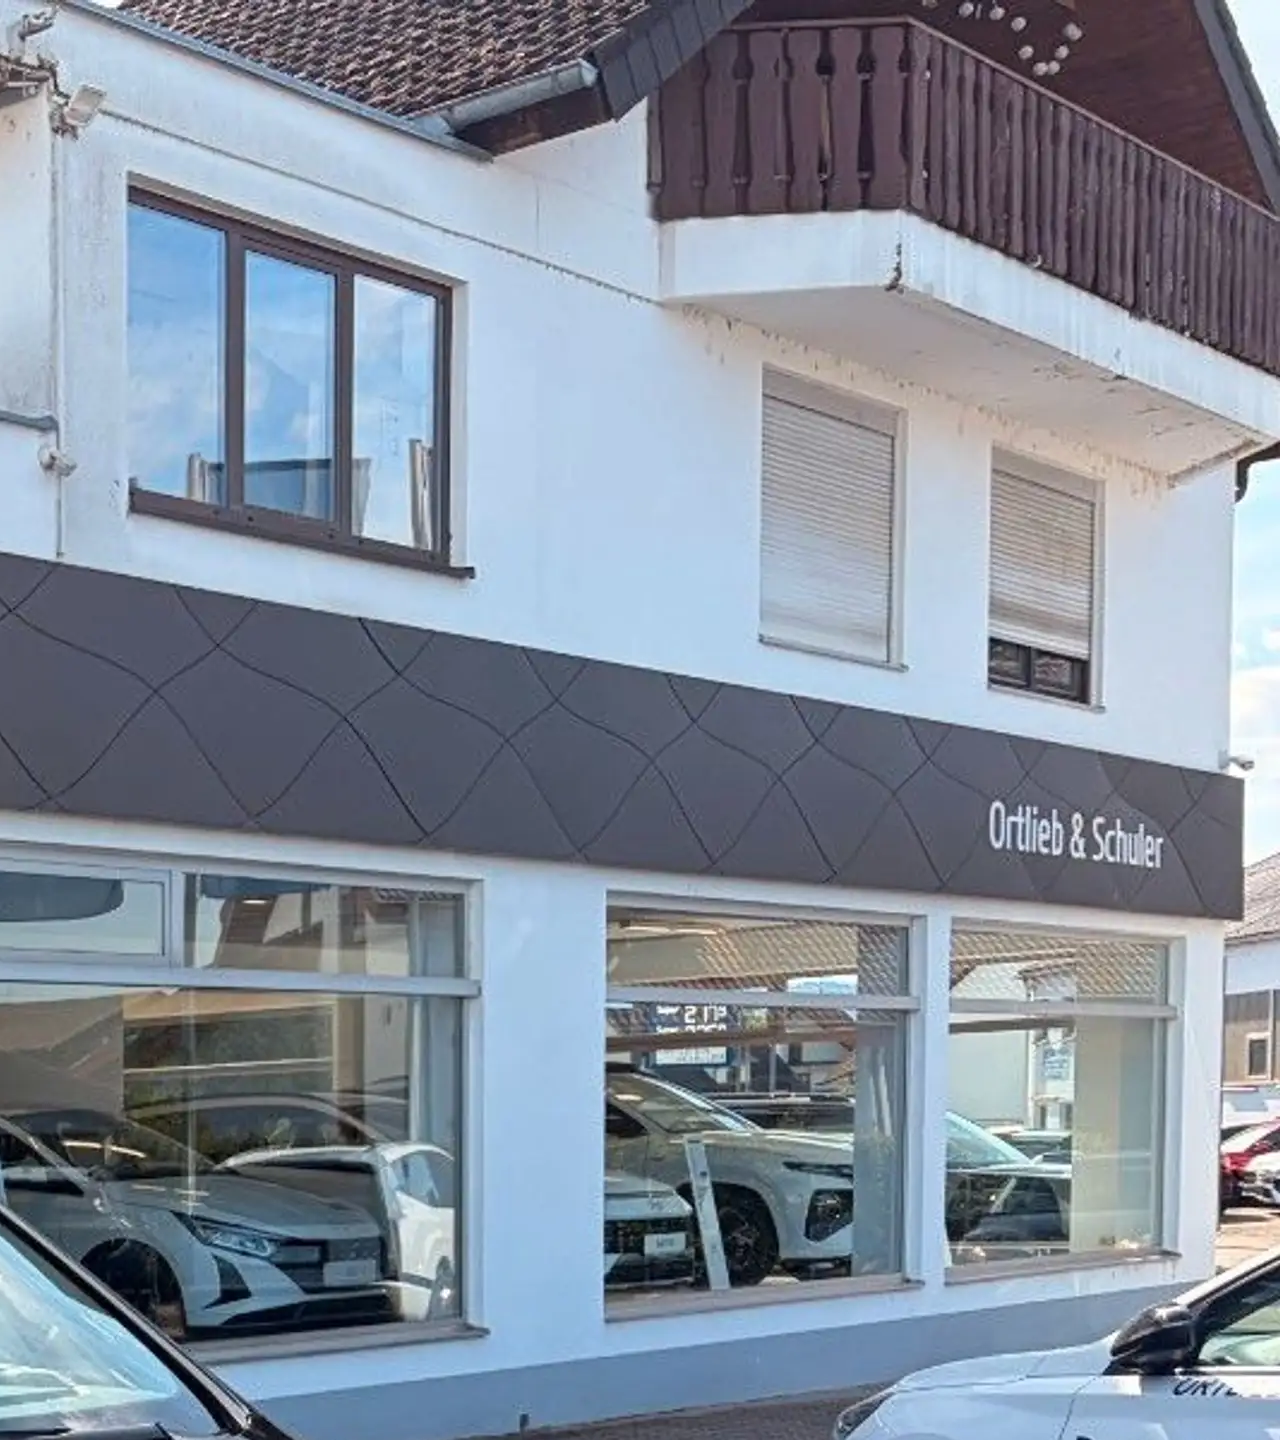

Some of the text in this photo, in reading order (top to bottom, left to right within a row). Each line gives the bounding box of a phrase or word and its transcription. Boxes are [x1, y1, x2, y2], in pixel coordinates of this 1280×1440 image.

[989, 800, 1164, 869] Ortlieb & Schuler
